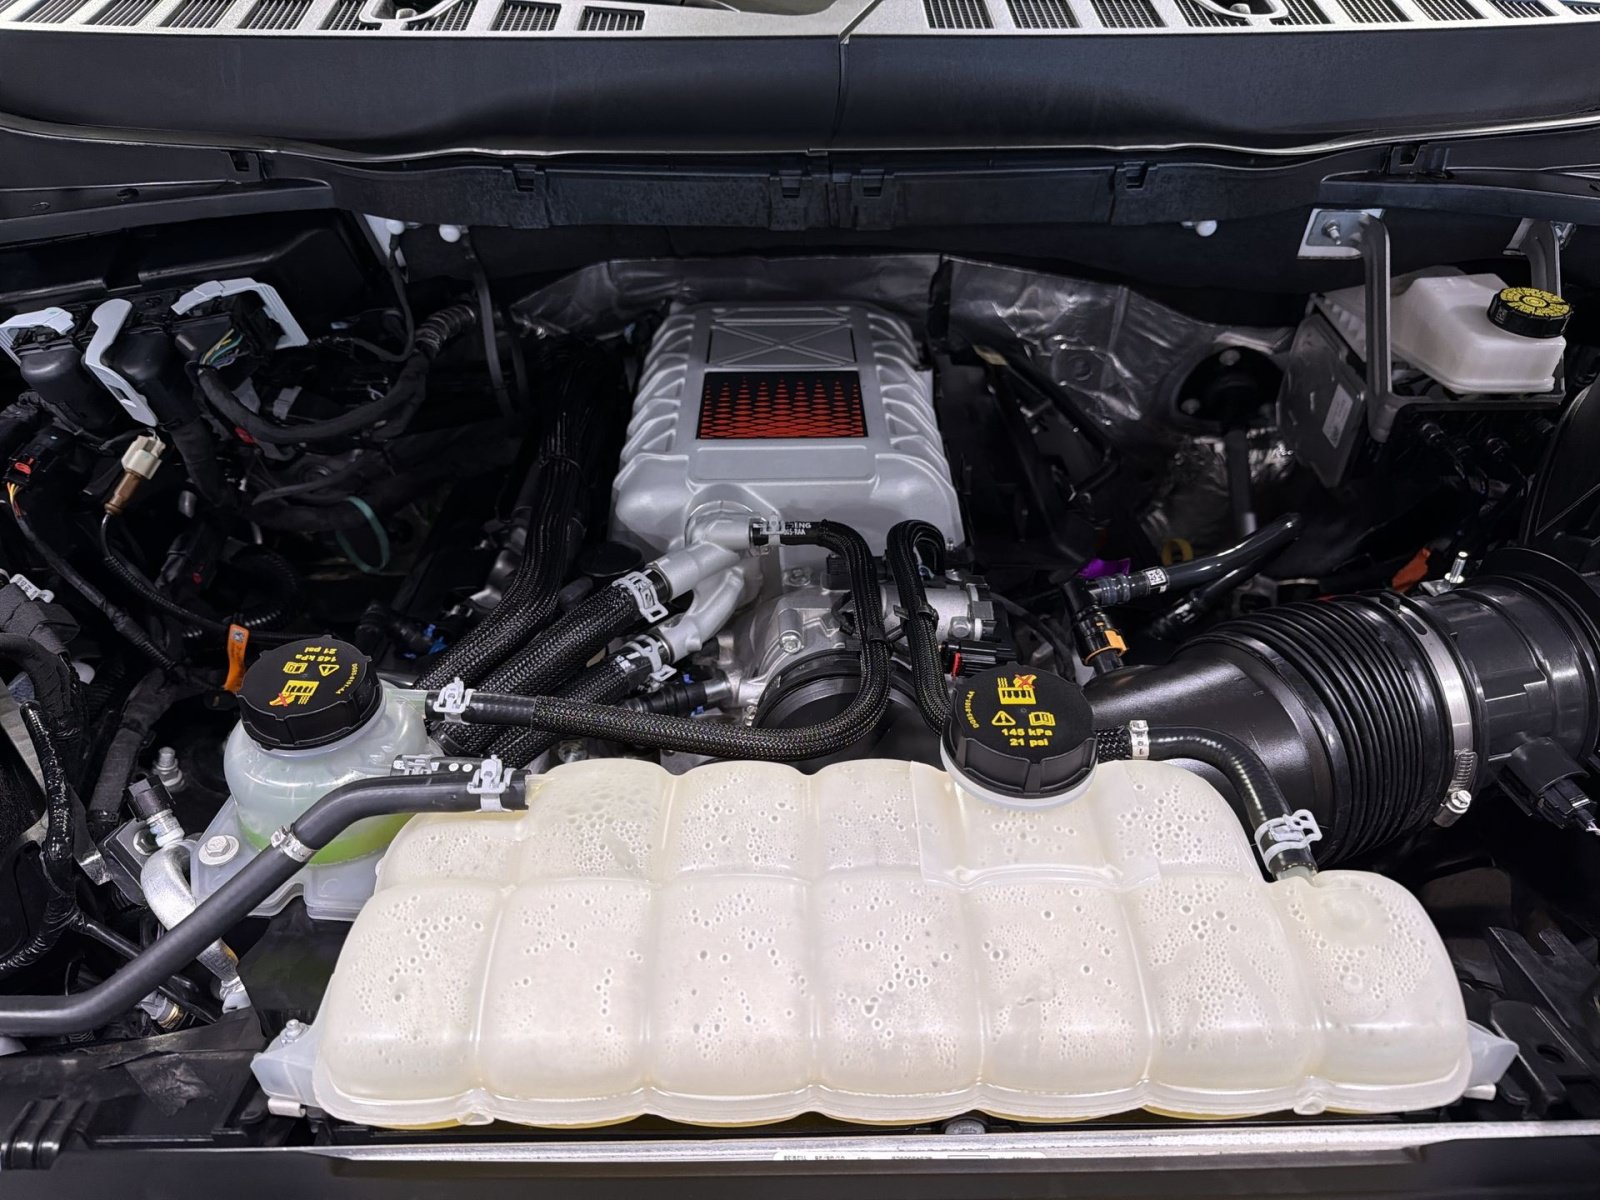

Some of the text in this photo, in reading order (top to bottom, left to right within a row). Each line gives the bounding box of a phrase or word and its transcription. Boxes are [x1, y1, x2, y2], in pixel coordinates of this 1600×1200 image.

[1001, 728, 1053, 736] 145 kPa
[1010, 738, 1049, 747] 21 psi
